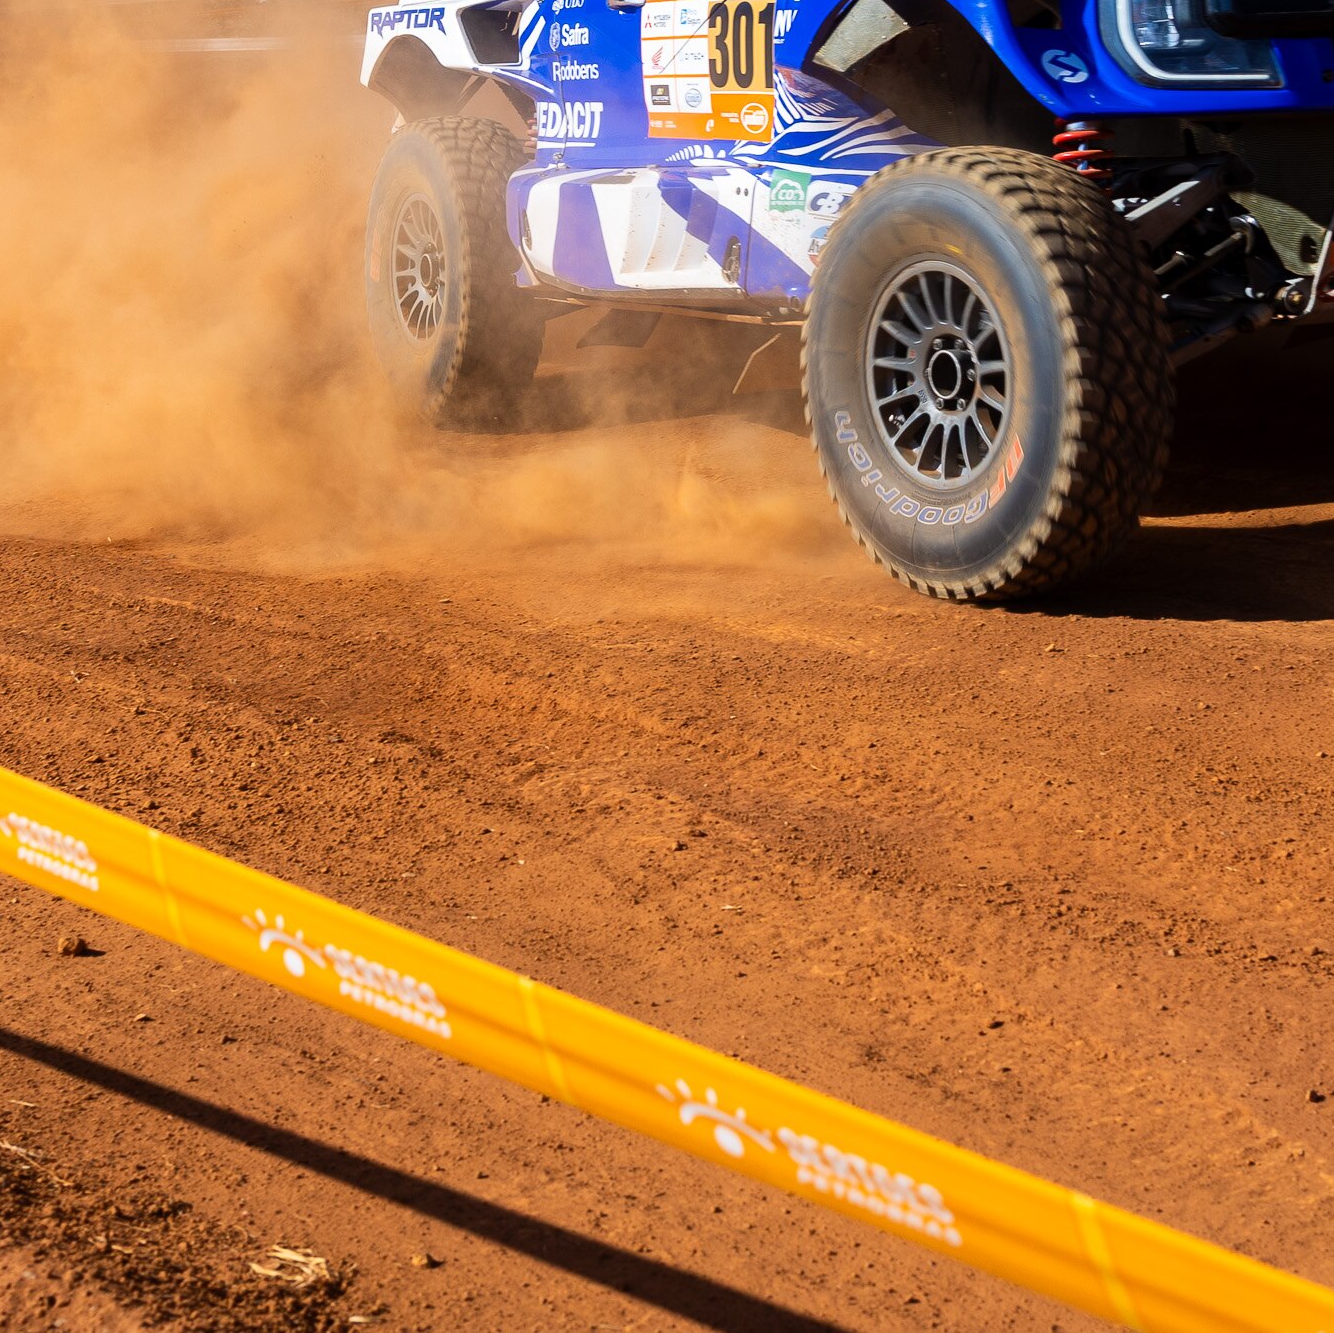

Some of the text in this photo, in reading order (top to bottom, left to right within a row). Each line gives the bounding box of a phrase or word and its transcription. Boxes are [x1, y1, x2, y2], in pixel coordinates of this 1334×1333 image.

[371, 7, 447, 39] RAPTOR
[561, 22, 589, 46] Safra
[708, 0, 775, 89] 301
[552, 60, 599, 81] Rodobens
